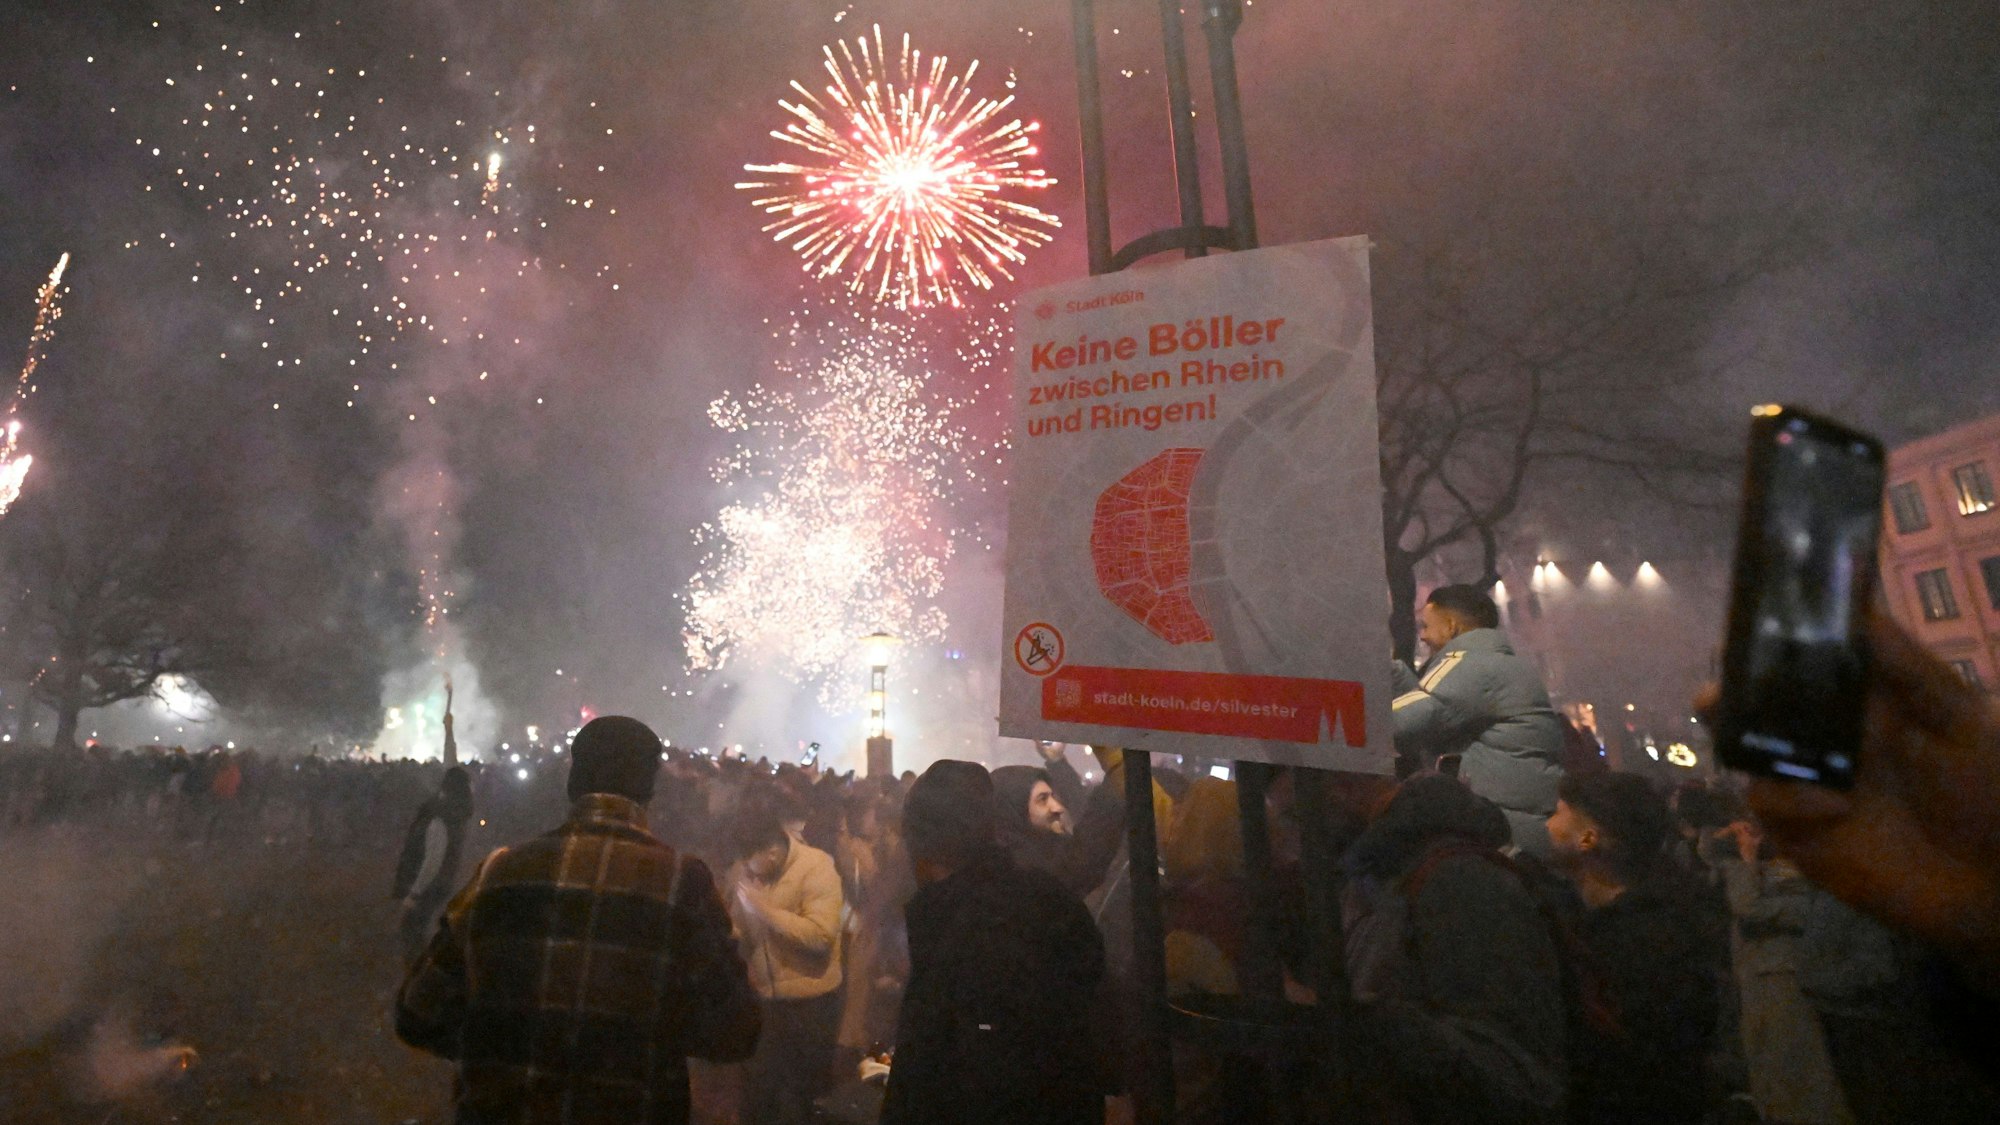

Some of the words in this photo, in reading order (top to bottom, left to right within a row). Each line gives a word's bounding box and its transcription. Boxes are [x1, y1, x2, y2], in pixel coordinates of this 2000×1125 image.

[1066, 297, 1105, 313] Stadt
[1110, 289, 1145, 306] Köln
[1031, 334, 1137, 373] Keine
[1149, 315, 1285, 357] Böller
[1029, 369, 1170, 405] zwischen
[1181, 353, 1284, 387] Rhein
[1028, 408, 1081, 437] und
[1091, 393, 1216, 431] Ringen!
[1094, 691, 1298, 718] stadt-koeln.de/silvester
